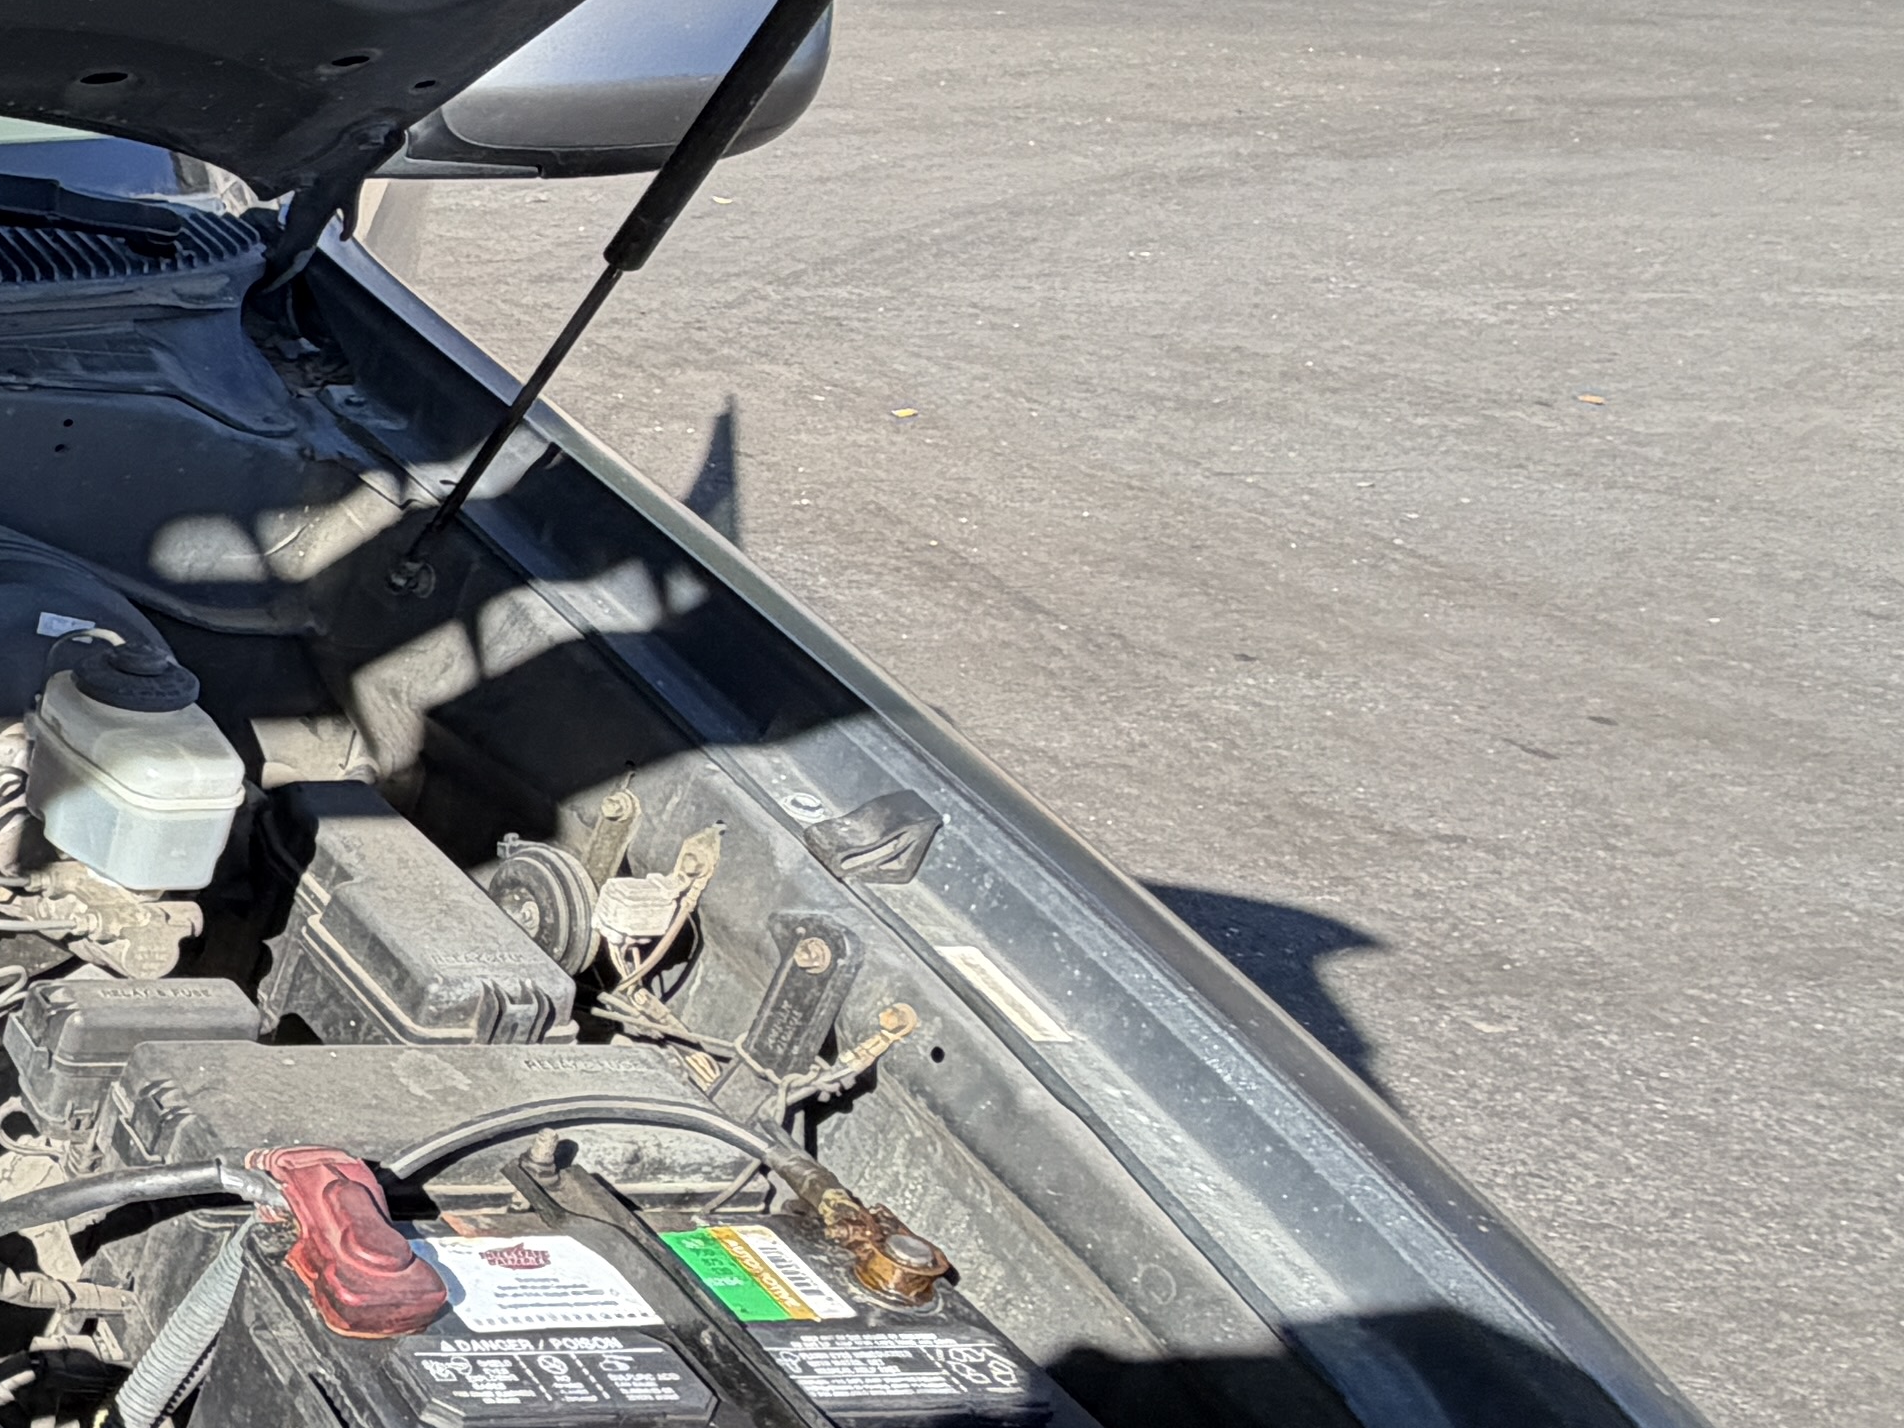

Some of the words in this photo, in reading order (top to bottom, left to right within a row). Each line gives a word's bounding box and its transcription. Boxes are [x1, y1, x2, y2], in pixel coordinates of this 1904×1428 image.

[98, 987, 150, 999] RELAY
[168, 988, 213, 998] FUSE
[723, 1238, 802, 1308] AUTOMOTIVE
[454, 1338, 535, 1352] DANGER
[548, 1337, 623, 1351] POISON
